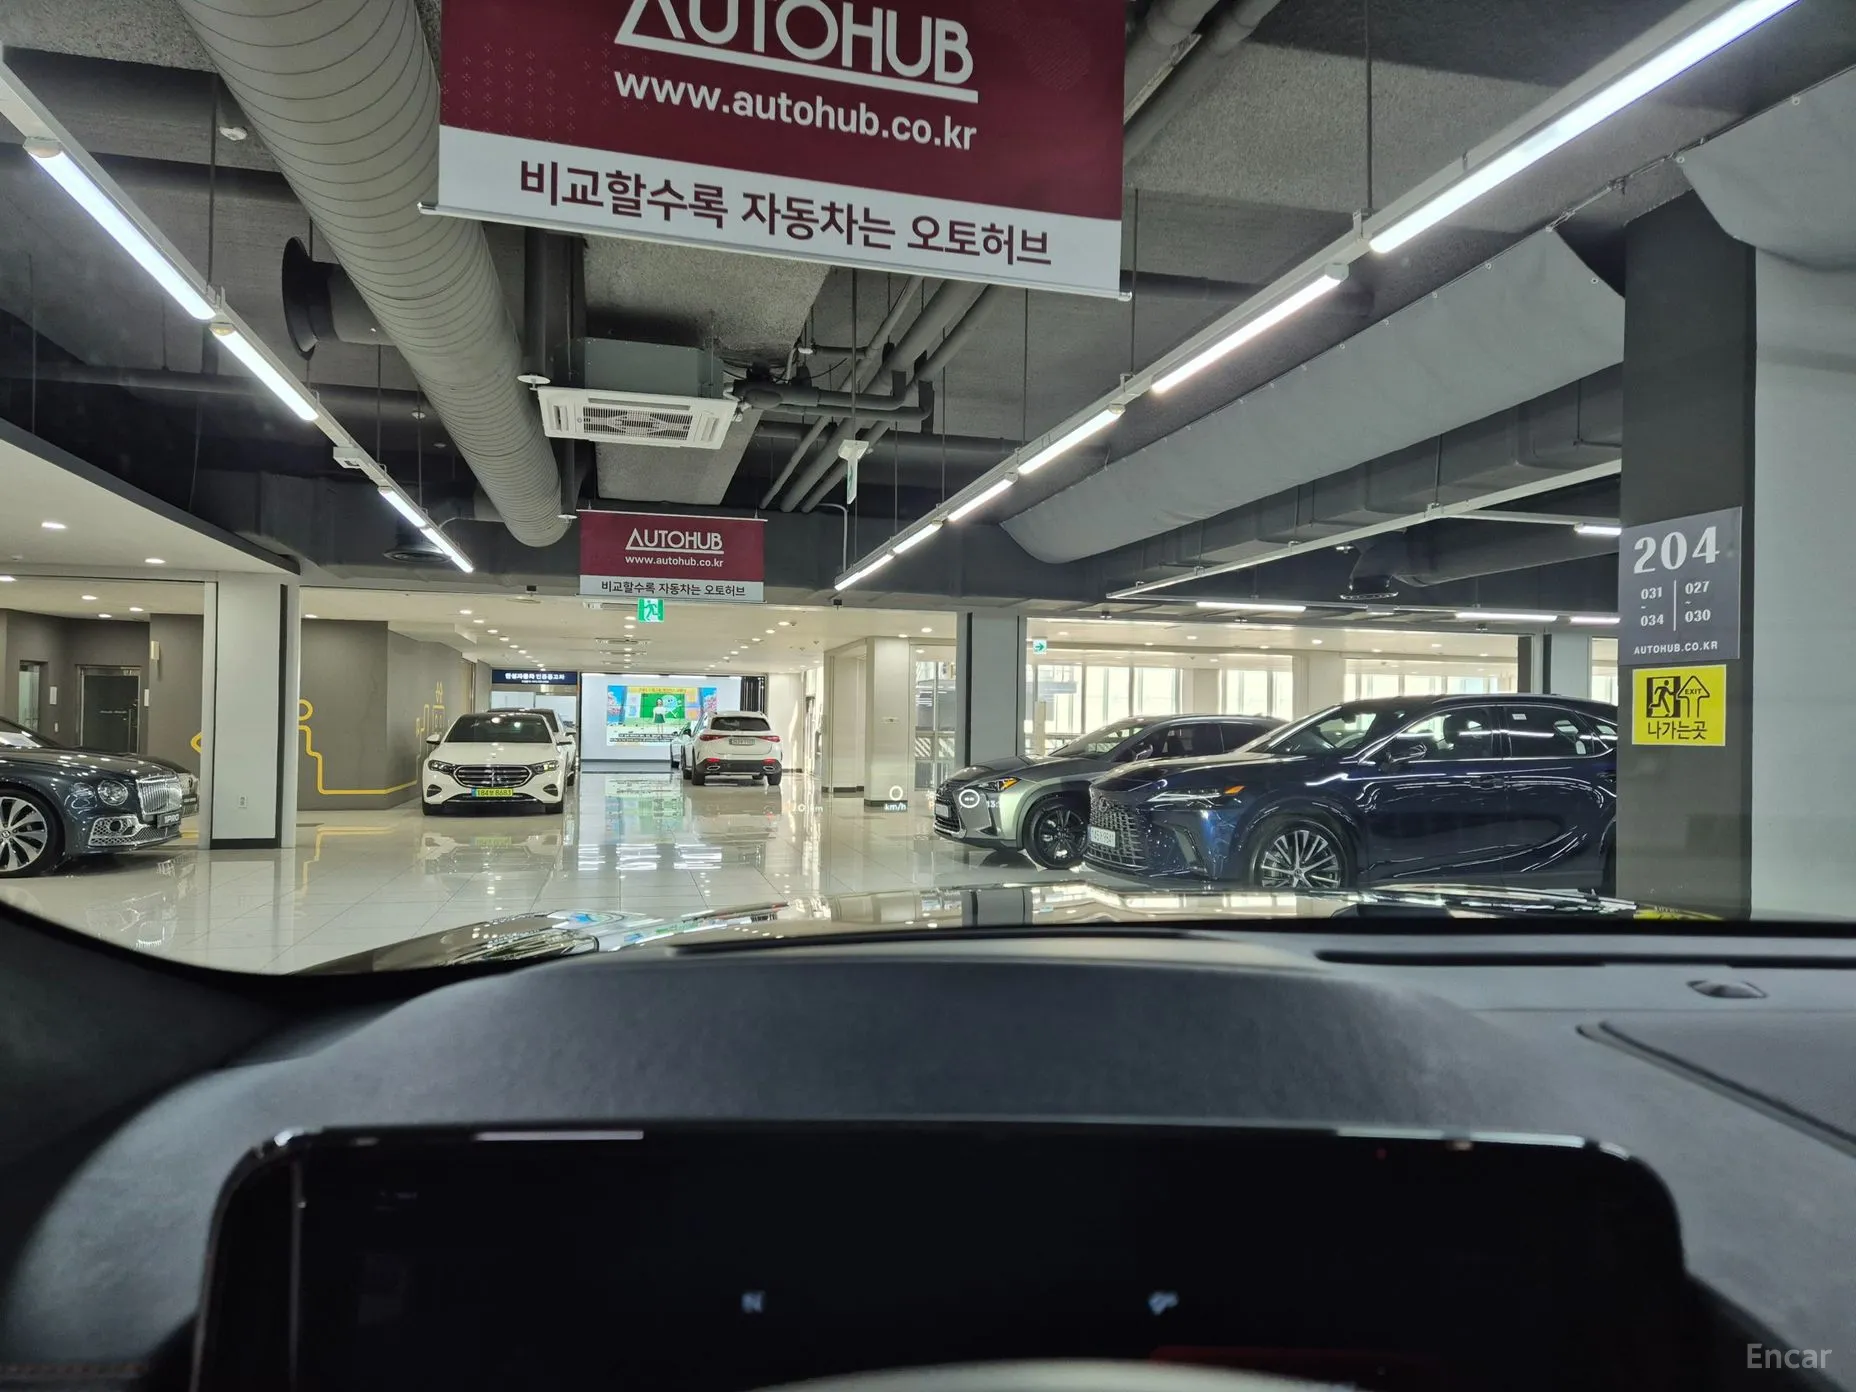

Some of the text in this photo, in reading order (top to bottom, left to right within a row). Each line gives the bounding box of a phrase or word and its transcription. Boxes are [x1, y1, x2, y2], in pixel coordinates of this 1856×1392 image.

[615, 0, 976, 86] AUTOHUB
[614, 70, 977, 151] www.autohub.co.kr
[520, 159, 1052, 266] 비교할수록 자동차는 오토허브
[625, 527, 723, 551] AUTOHUB
[1633, 526, 1720, 574] 204
[625, 556, 724, 568] www.autohub.co.kr
[601, 581, 746, 597] 비교할수록 자동차는 오토허브
[1640, 586, 1663, 600] 031
[1685, 581, 1710, 595] 027
[1640, 614, 1664, 627] 034
[1684, 609, 1711, 623] 030
[1633, 641, 1719, 655] AUTOHUB.CO.KR
[1684, 687, 1703, 696] EXIT
[1647, 721, 1708, 741] 나가는곳
[884, 801, 907, 812] km/h
